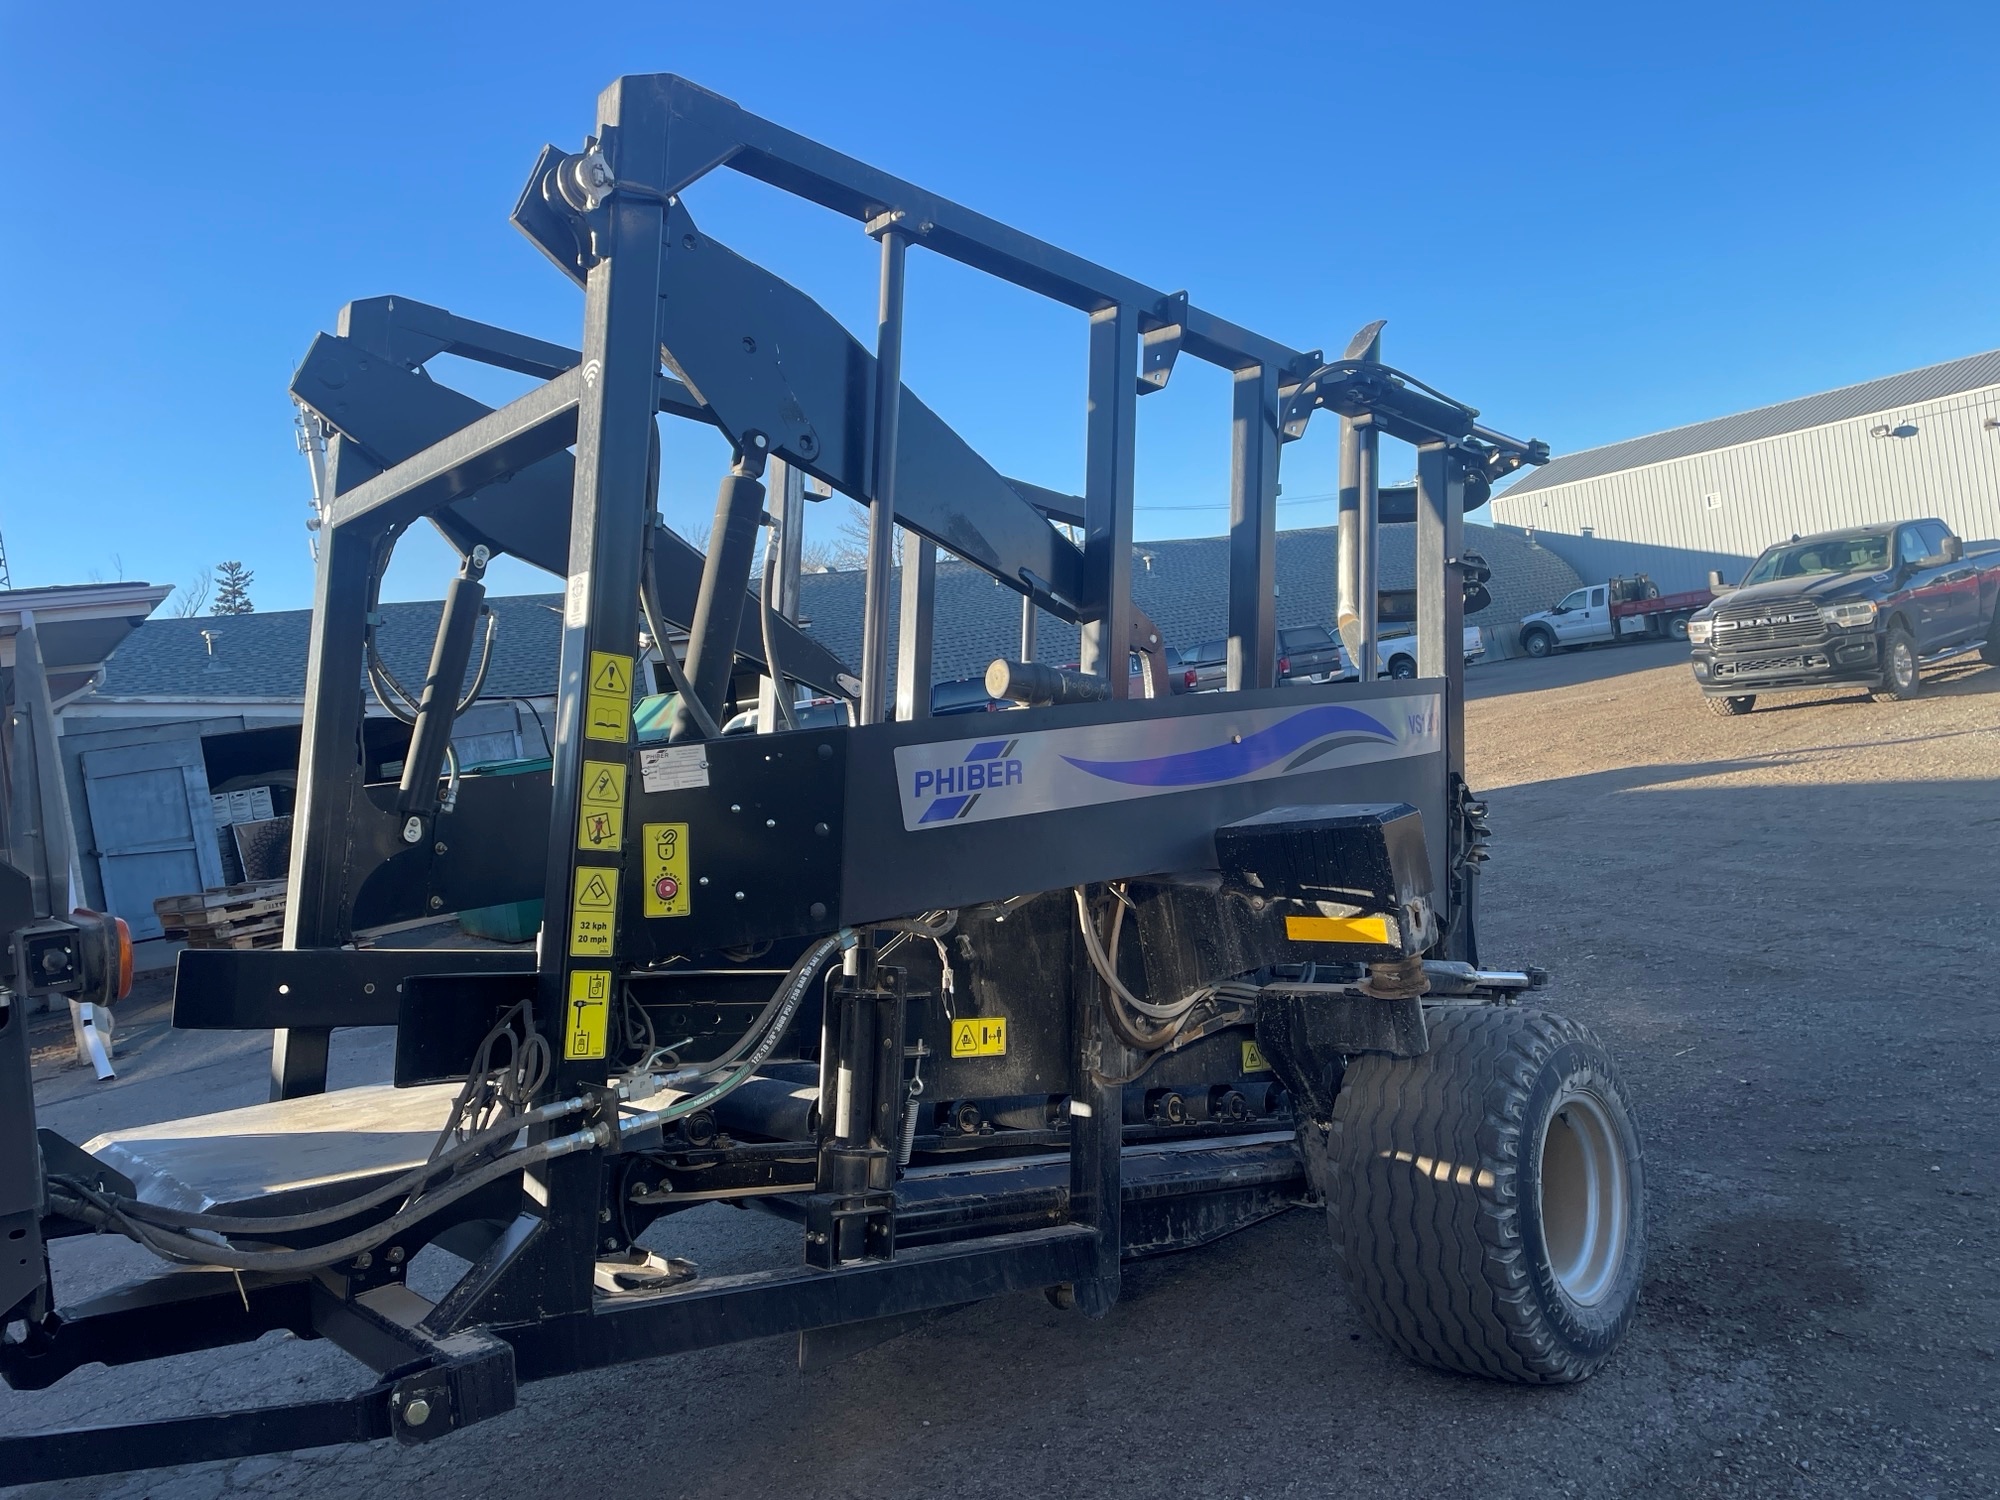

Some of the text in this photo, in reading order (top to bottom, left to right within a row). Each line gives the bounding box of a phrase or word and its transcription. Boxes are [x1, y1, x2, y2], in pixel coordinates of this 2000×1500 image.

[1739, 616, 1787, 629] RAM
[645, 752, 669, 760] PHIBER
[914, 759, 1023, 798] PHIBER
[651, 872, 683, 887] EMERGENCY
[580, 921, 607, 932] 32 kph
[577, 934, 607, 945] 20 mph
[775, 1016, 786, 1031] 3600
[784, 1005, 793, 1015] PSI
[791, 988, 800, 1000] 250
[799, 976, 807, 988] BAR
[694, 1093, 714, 1106] NOVA
